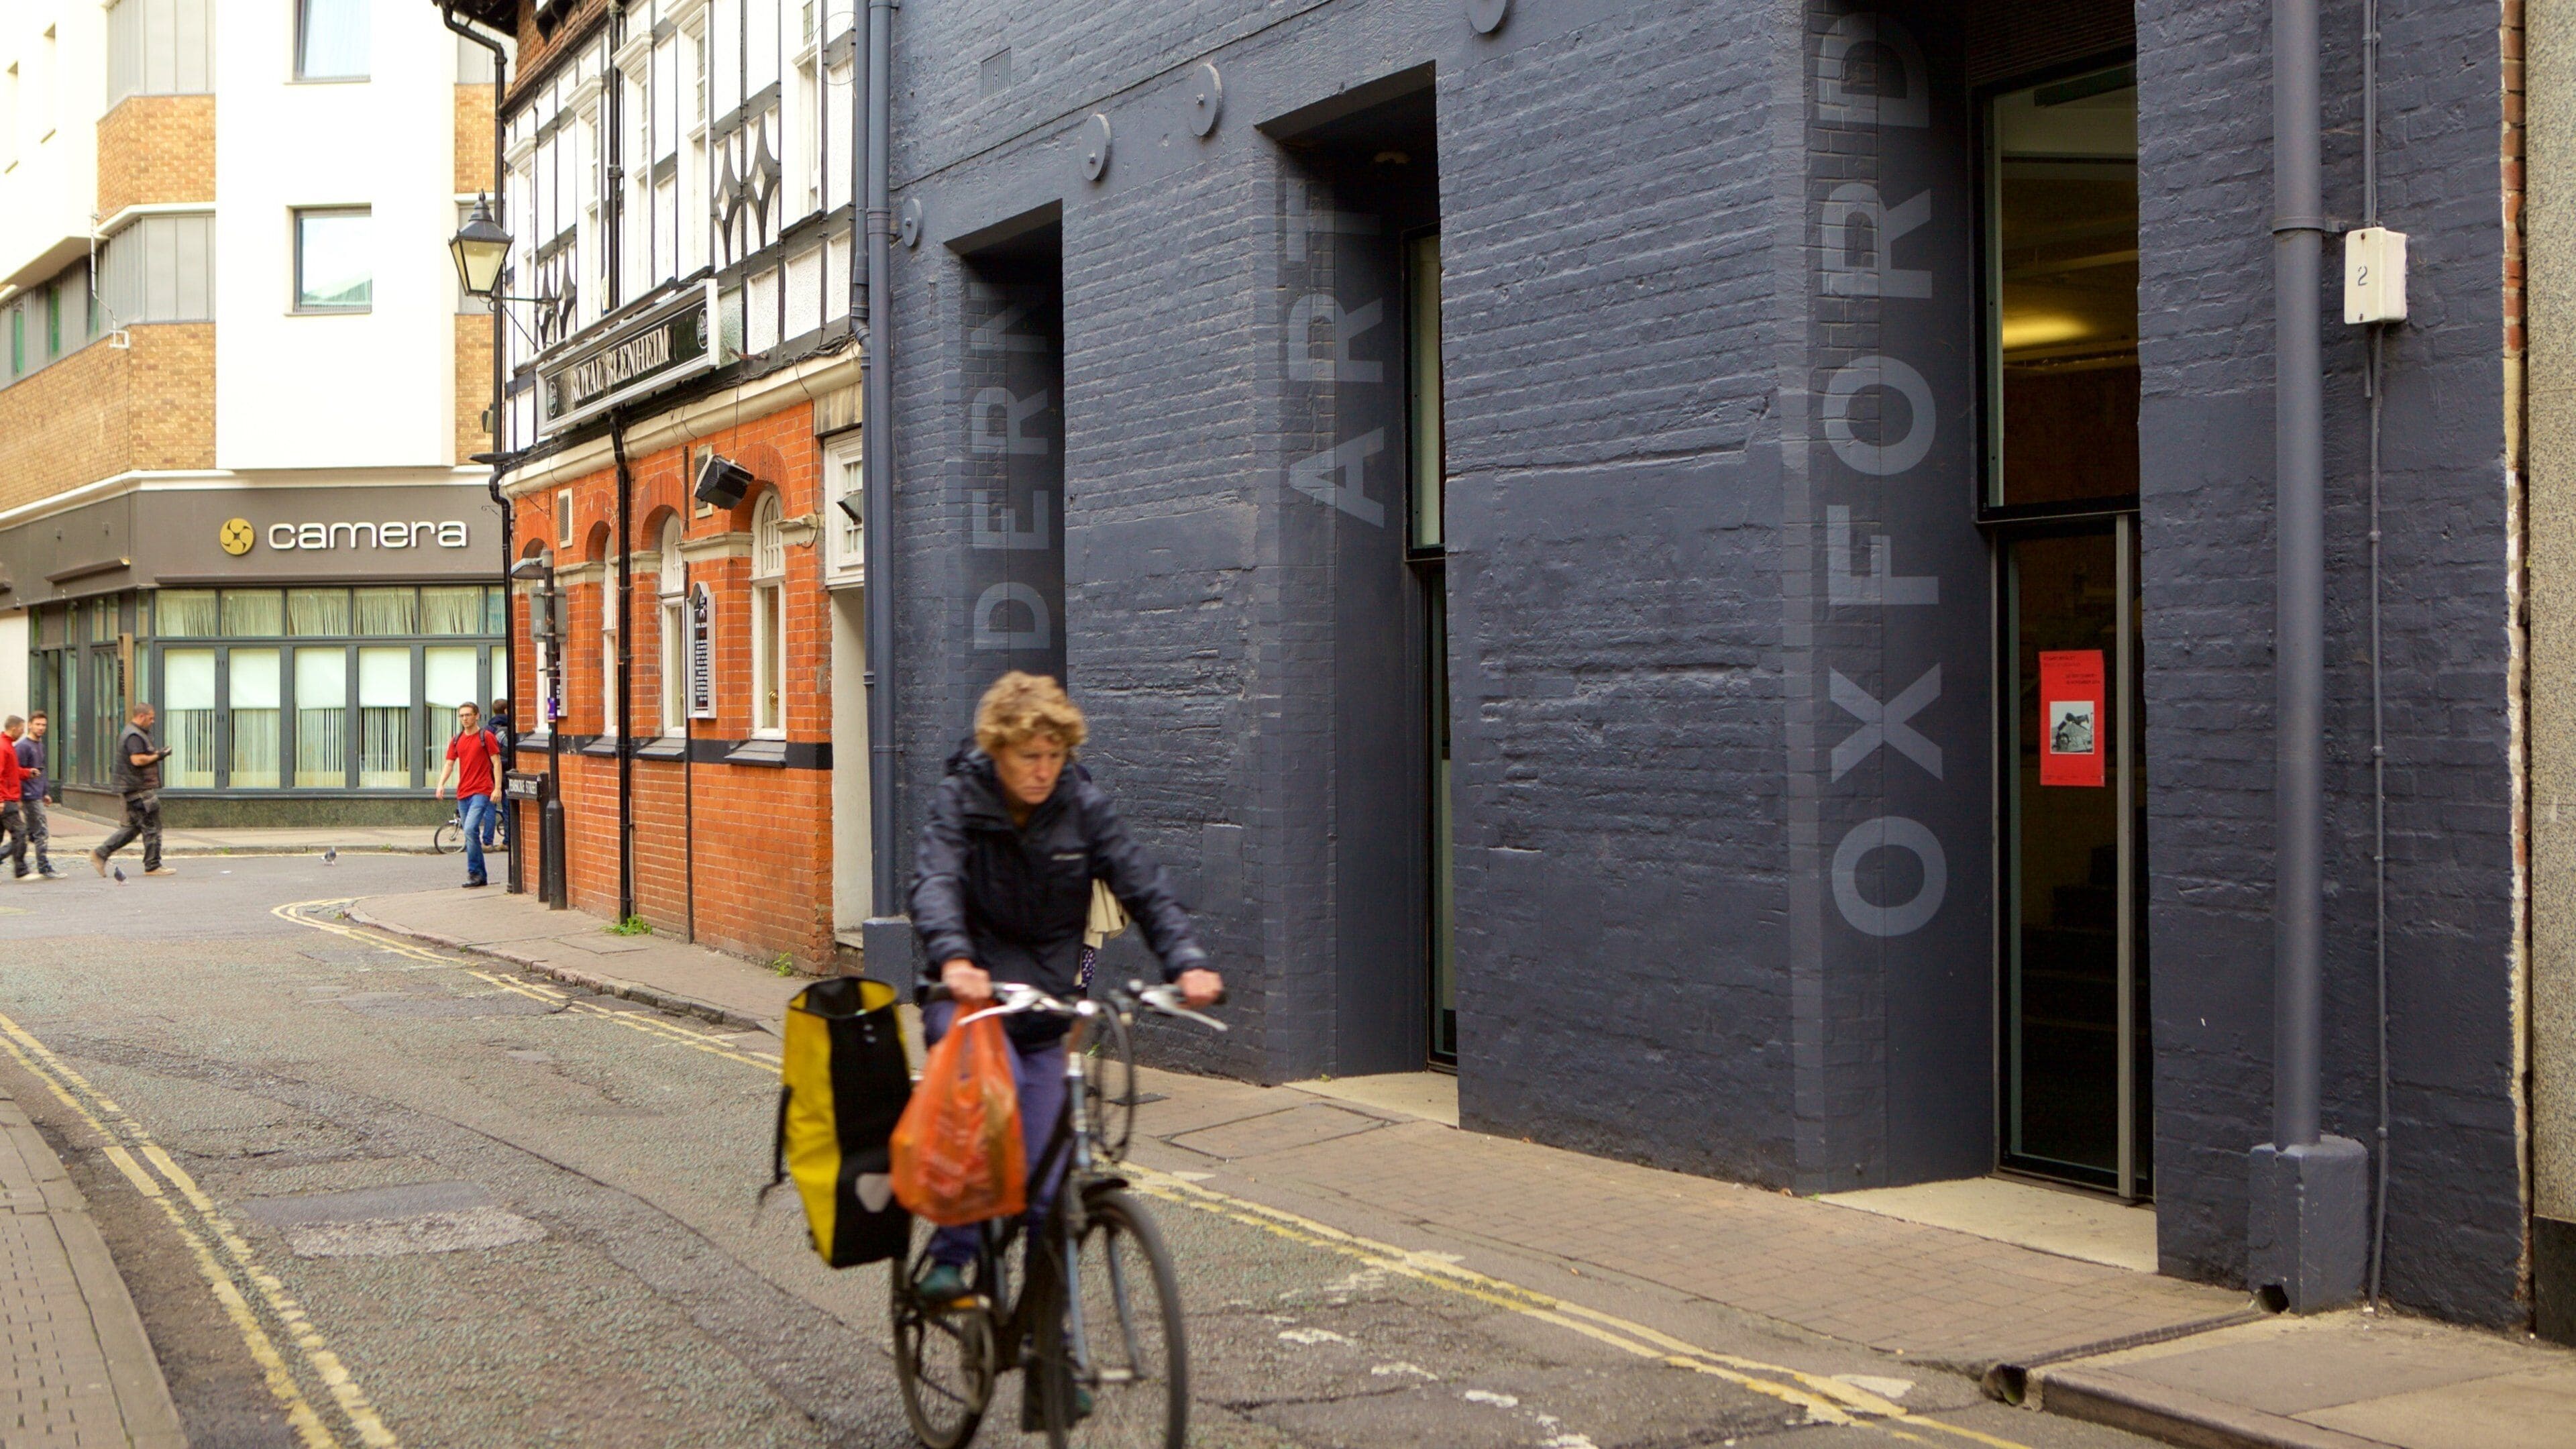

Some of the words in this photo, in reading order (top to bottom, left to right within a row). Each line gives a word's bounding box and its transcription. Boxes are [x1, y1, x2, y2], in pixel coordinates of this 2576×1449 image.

[571, 356, 604, 402] ROYAL
[604, 324, 670, 387] BLENHEIM
[1286, 176, 1385, 529] ART
[2357, 265, 2369, 286] 2
[268, 521, 468, 549] camera
[969, 282, 1051, 650] DERN
[1819, 11, 1948, 937] OXFORD
